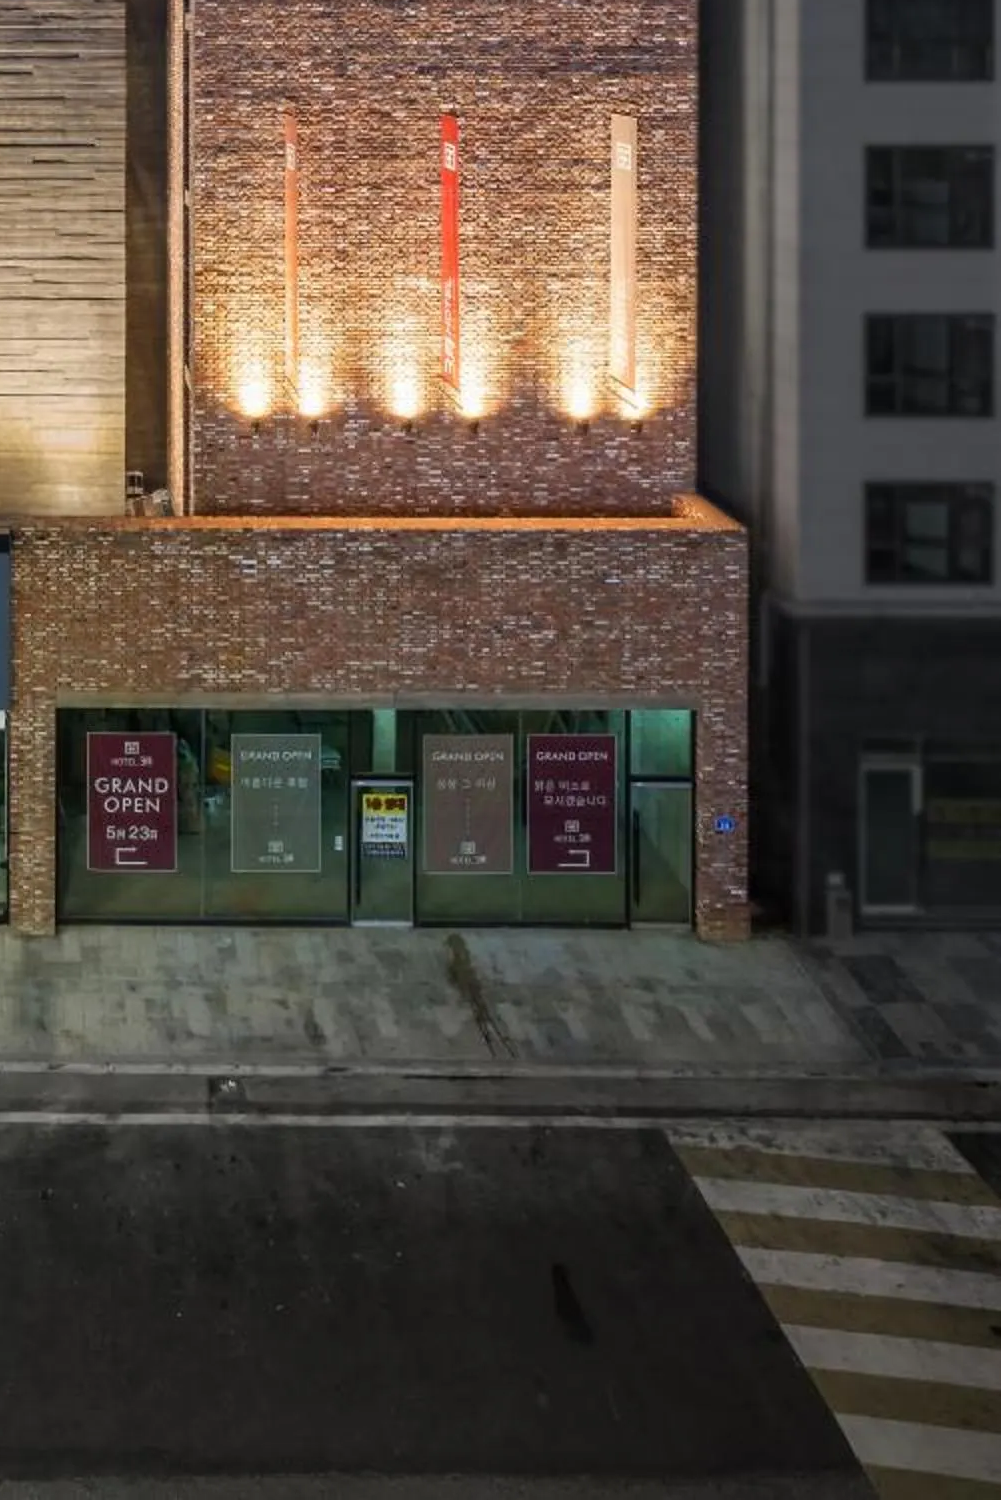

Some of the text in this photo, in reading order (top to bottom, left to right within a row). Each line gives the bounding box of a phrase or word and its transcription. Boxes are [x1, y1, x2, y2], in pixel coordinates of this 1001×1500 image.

[240, 750, 313, 761] GRAND OPEN
[432, 750, 505, 762] GRAND OPEN
[536, 750, 609, 762] GRAND OPEN
[94, 777, 169, 794] GRAND
[103, 796, 161, 814] OPEN
